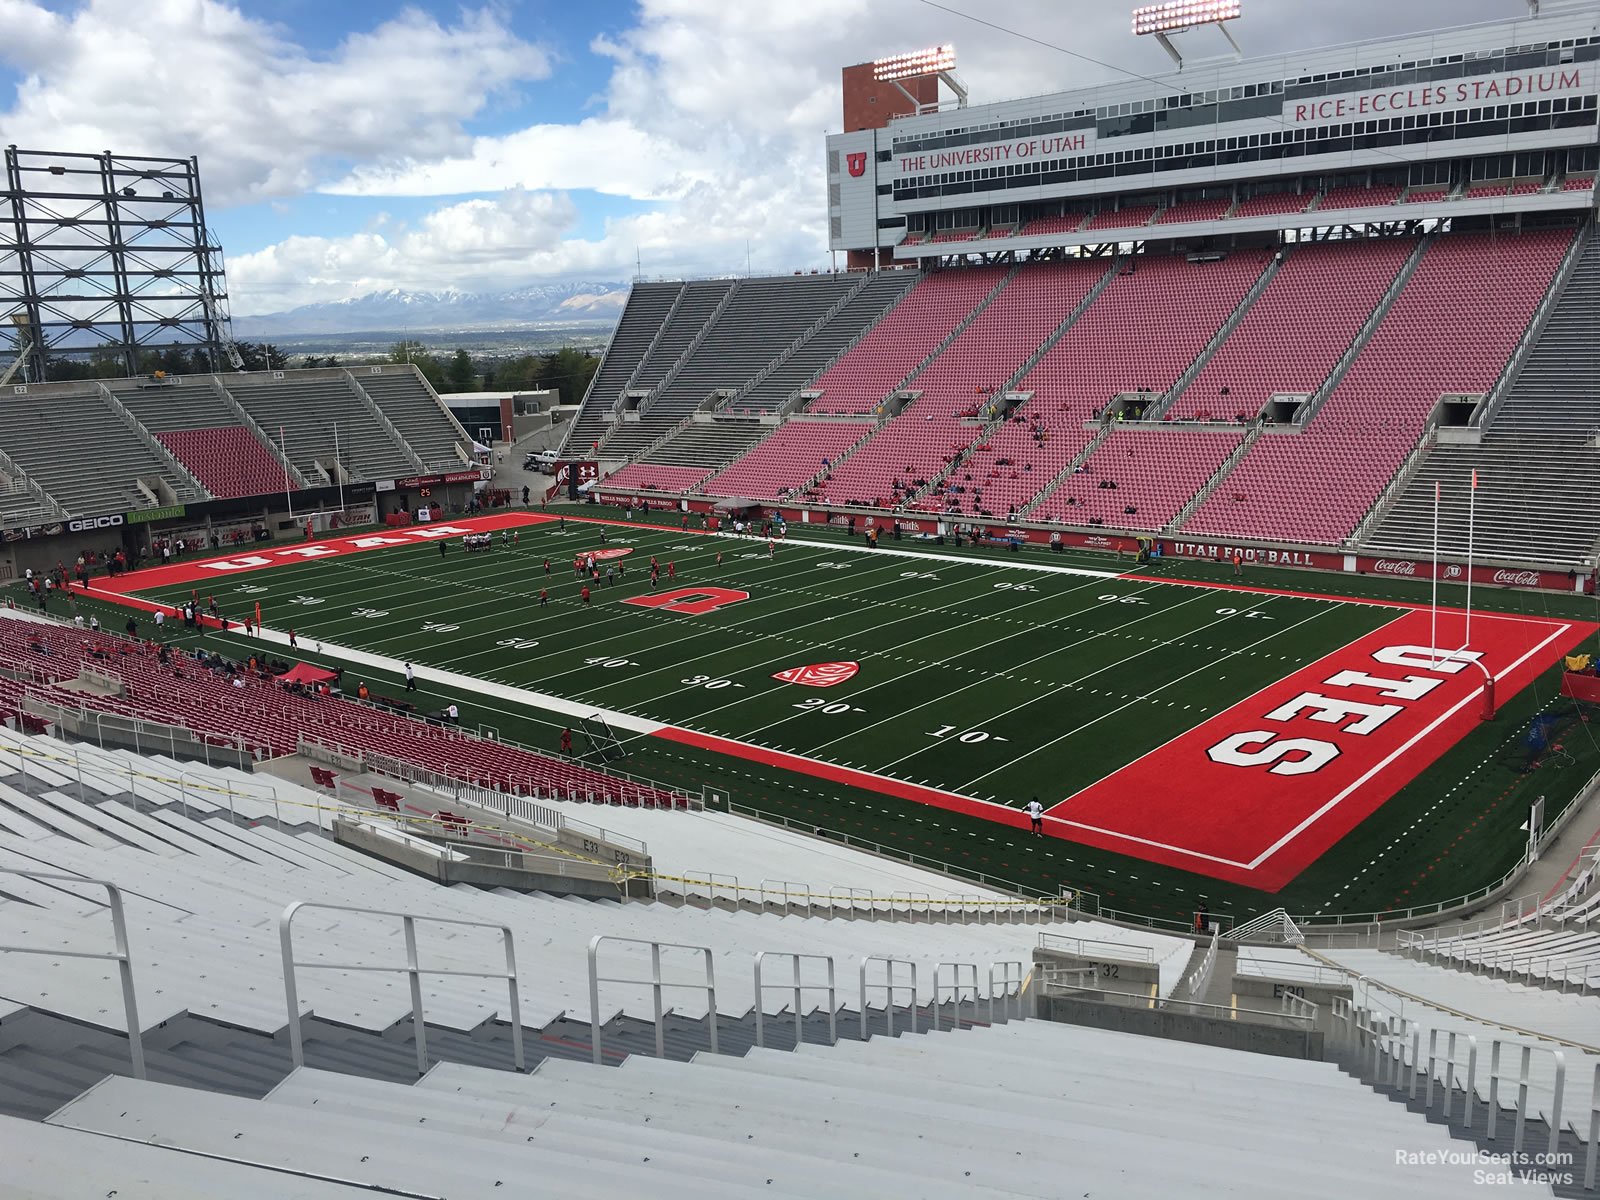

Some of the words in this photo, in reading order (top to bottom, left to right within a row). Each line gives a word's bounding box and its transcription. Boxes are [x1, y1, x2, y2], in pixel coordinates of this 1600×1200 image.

[1295, 86, 1447, 122] RICE-ECCLES
[1456, 69, 1580, 102] STADIUM
[900, 155, 926, 172] THE
[930, 147, 1006, 168] UNIVERSITY
[1016, 142, 1037, 156] OF
[1042, 135, 1085, 154] UTAH
[846, 152, 867, 177] U
[421, 488, 431, 497] 25
[69, 515, 124, 532] GEICO
[199, 526, 475, 571] UTAH
[1175, 543, 1218, 557] UTAH
[1374, 559, 1416, 575] Coca-Cola
[1493, 569, 1540, 585] Coca-Cola
[496, 637, 540, 649] 50
[583, 656, 629, 668] 40
[680, 674, 732, 689] 30
[791, 698, 851, 714] 20
[1204, 643, 1487, 777] UTES
[924, 724, 990, 743] 10
[583, 839, 599, 854] E33
[615, 849, 630, 864] E32
